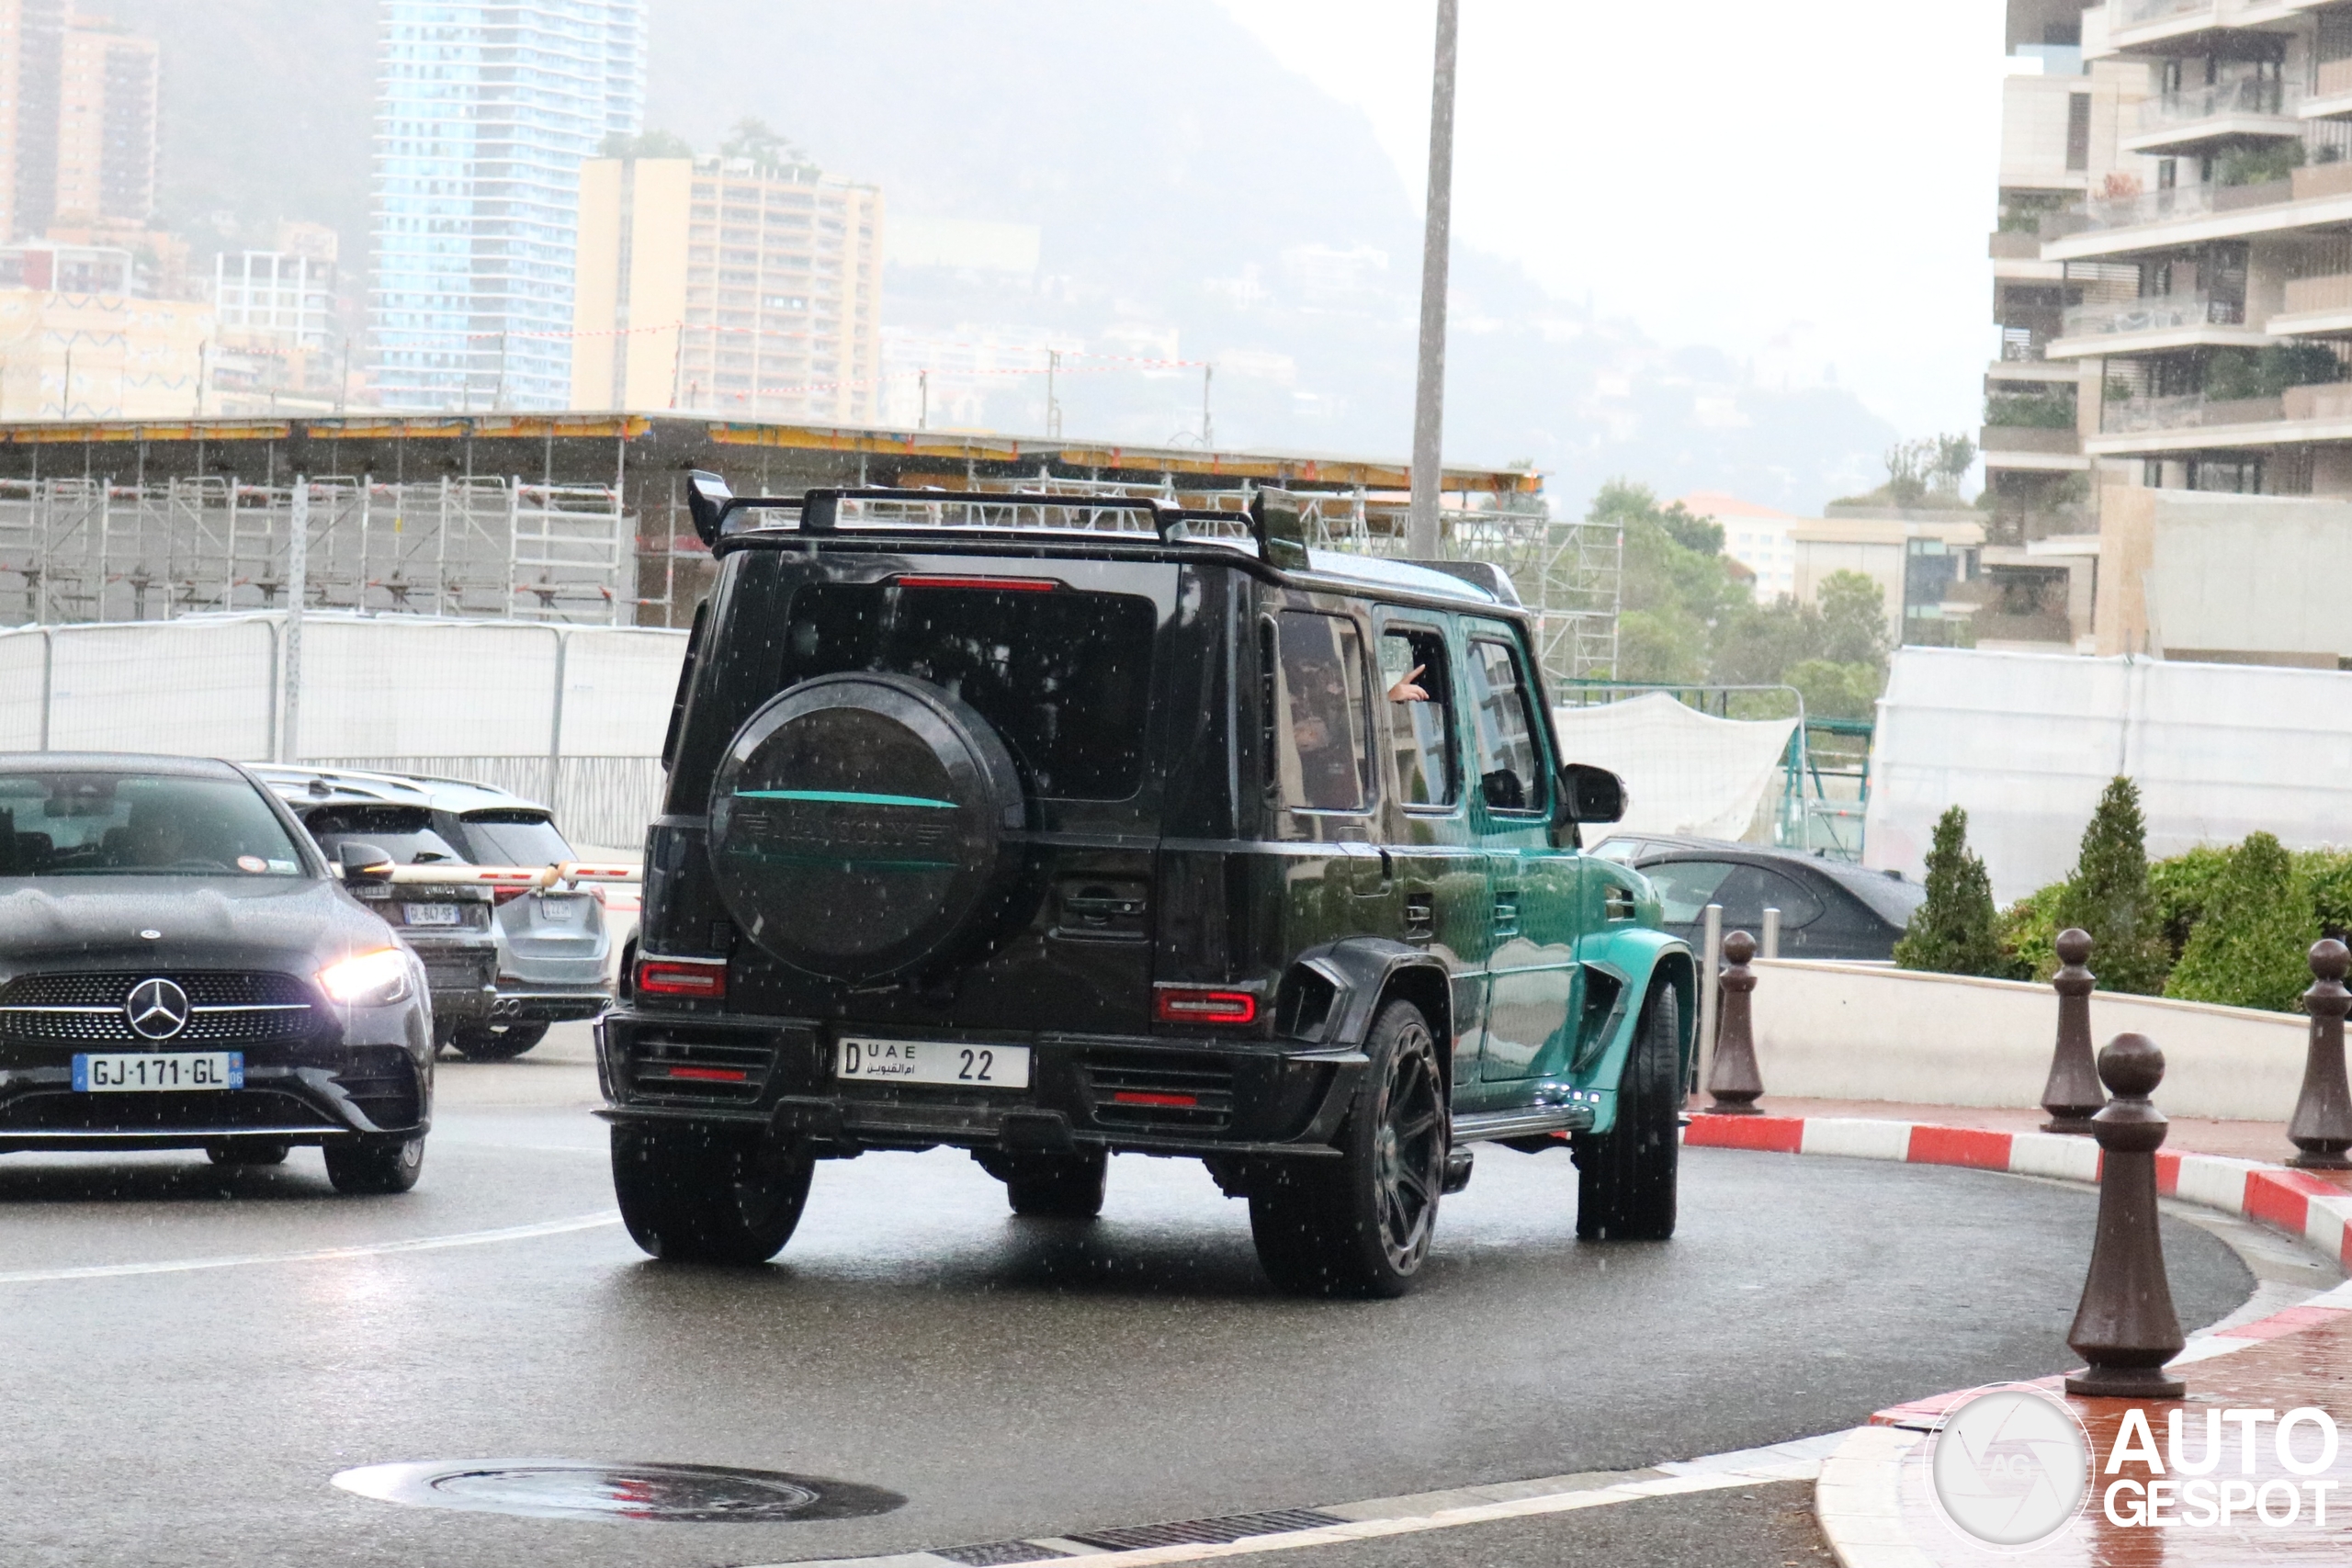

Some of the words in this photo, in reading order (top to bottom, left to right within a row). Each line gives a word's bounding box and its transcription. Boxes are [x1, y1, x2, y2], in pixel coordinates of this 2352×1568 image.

[844, 1043, 861, 1074] D
[867, 1044, 916, 1059] UAE
[94, 1059, 222, 1085] GJ-171-GL
[230, 1071, 243, 1084] 06
[958, 1049, 994, 1081] 22
